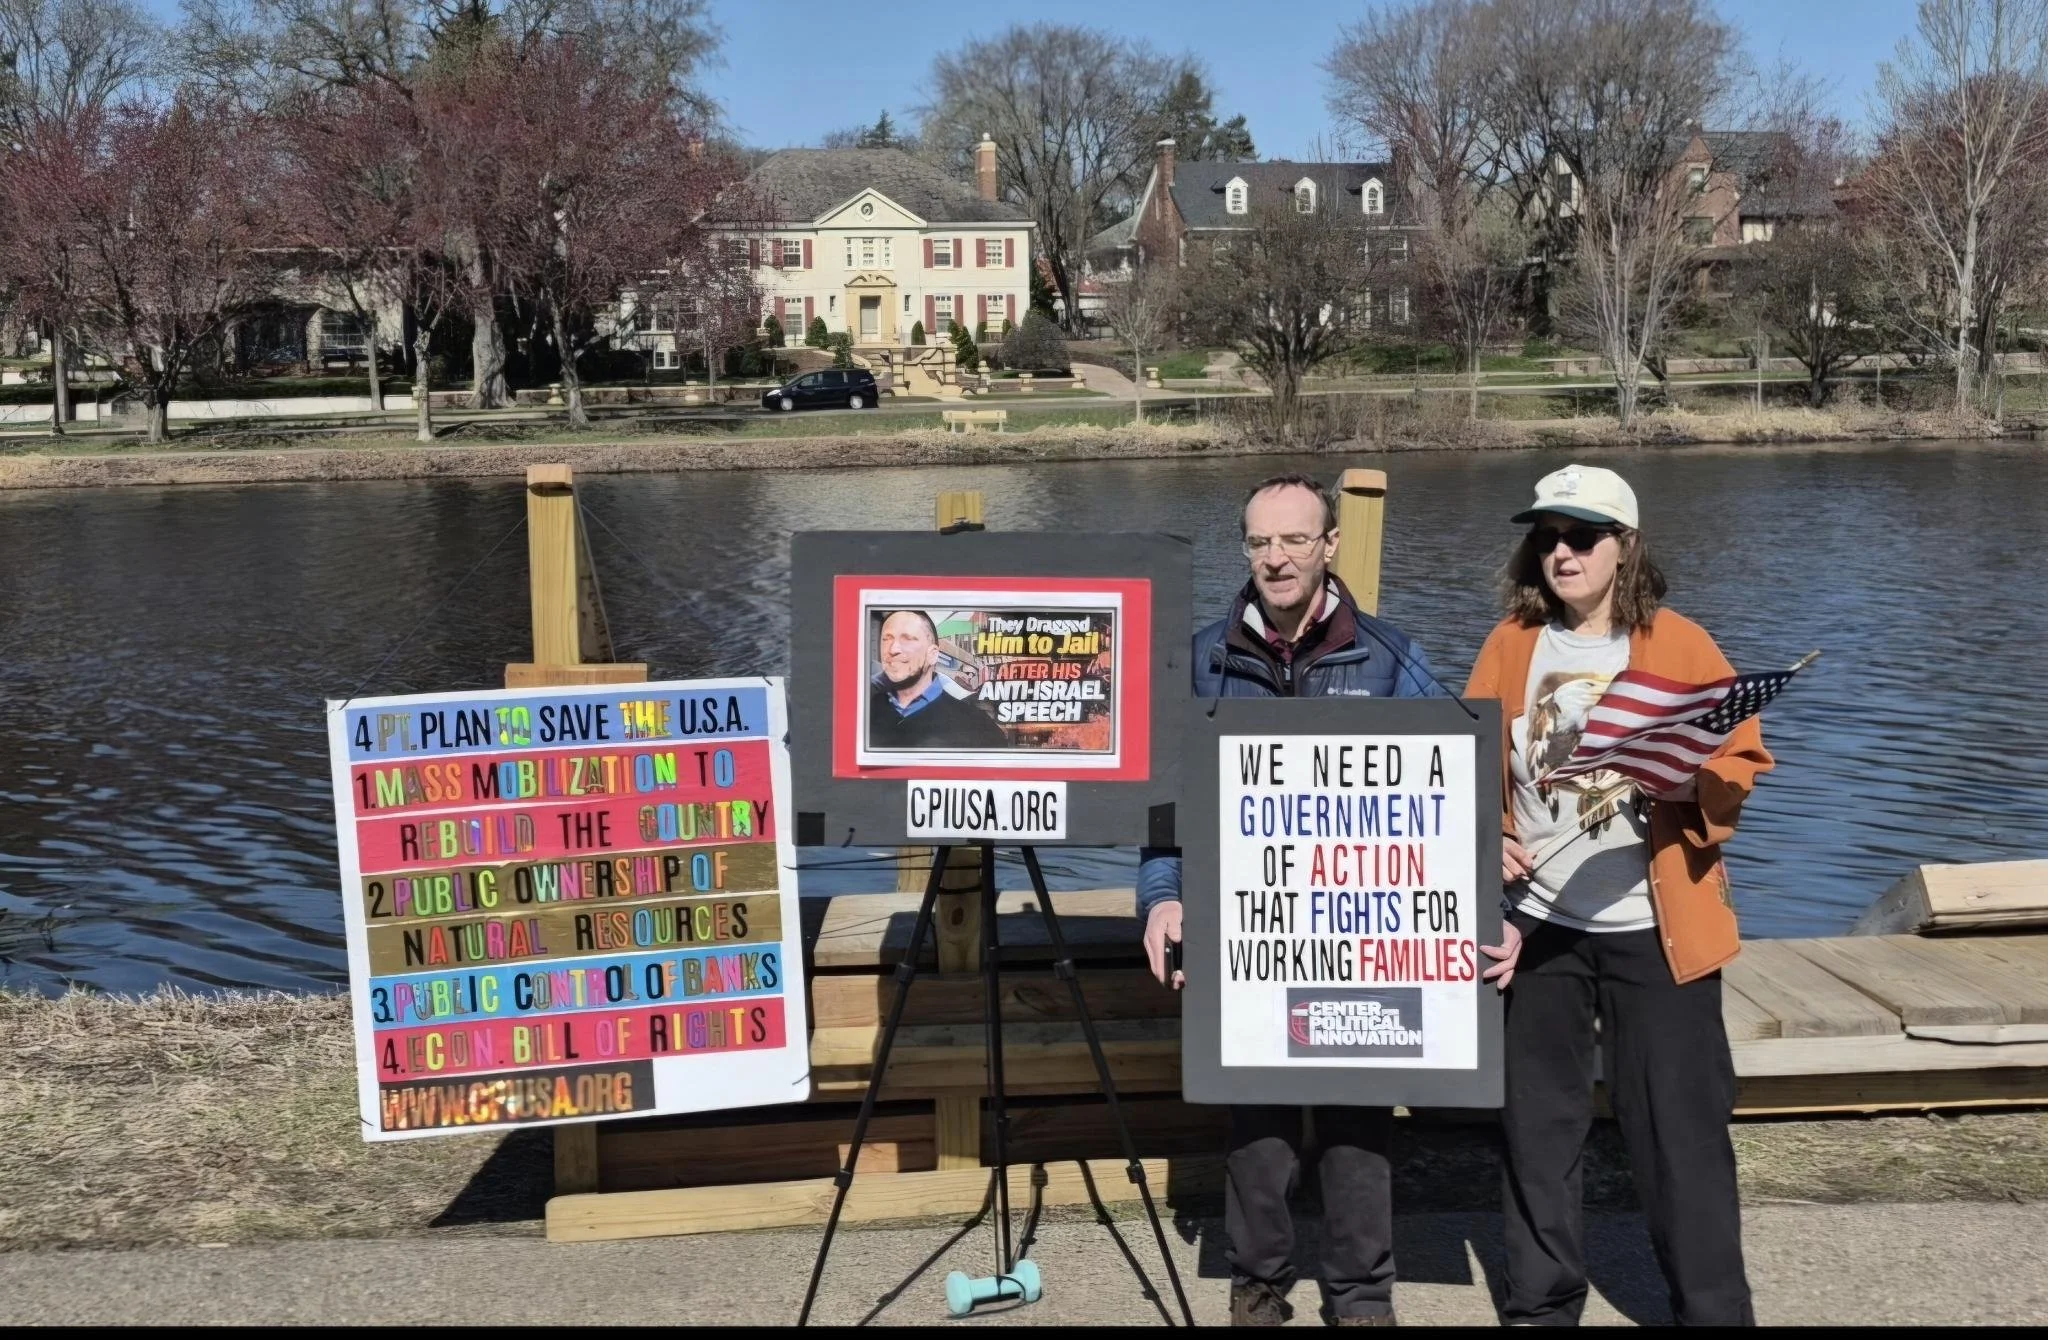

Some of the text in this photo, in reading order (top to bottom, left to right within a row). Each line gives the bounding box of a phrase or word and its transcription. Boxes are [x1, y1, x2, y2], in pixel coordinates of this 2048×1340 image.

[977, 631, 1100, 654] Him to Jail
[988, 616, 1024, 635] They
[978, 680, 1105, 701] ANTI-ISRAEL
[996, 662, 1082, 680] AFTER HIS
[354, 715, 373, 752] 4
[420, 708, 491, 749] PLAN
[494, 706, 532, 746] TO
[539, 704, 610, 742] SAVE
[619, 699, 673, 739] THE
[679, 695, 749, 735] U.S.A.
[997, 702, 1082, 723] SPEECH
[472, 752, 677, 800] MOBILIZATION
[694, 748, 735, 789] TO
[1239, 743, 1445, 788] WE NEED A
[400, 800, 769, 861] REBUILD THE COUNTRY
[910, 786, 1058, 832] CPIUSA.ORG
[1239, 793, 1446, 838] GOVERNMENT
[514, 856, 680, 903] OWNERSHIP
[691, 851, 729, 893] OF
[1263, 843, 1425, 887] OF ACTION
[403, 902, 748, 966] NATURAL RESOURCES
[1234, 890, 1460, 935] THAT FIGHTS FOR
[514, 963, 639, 1010] CONTROL
[645, 960, 677, 999] OF
[682, 952, 778, 997] BANKS
[1228, 938, 1476, 982] WORKING FAMILIES
[1308, 1001, 1382, 1016] CENTER
[1309, 1015, 1405, 1031] POLITICAL
[512, 1022, 579, 1064] BILL
[595, 1016, 632, 1056] OF
[650, 1007, 767, 1053] RIGHTS
[1309, 1030, 1422, 1046] INNOVATION
